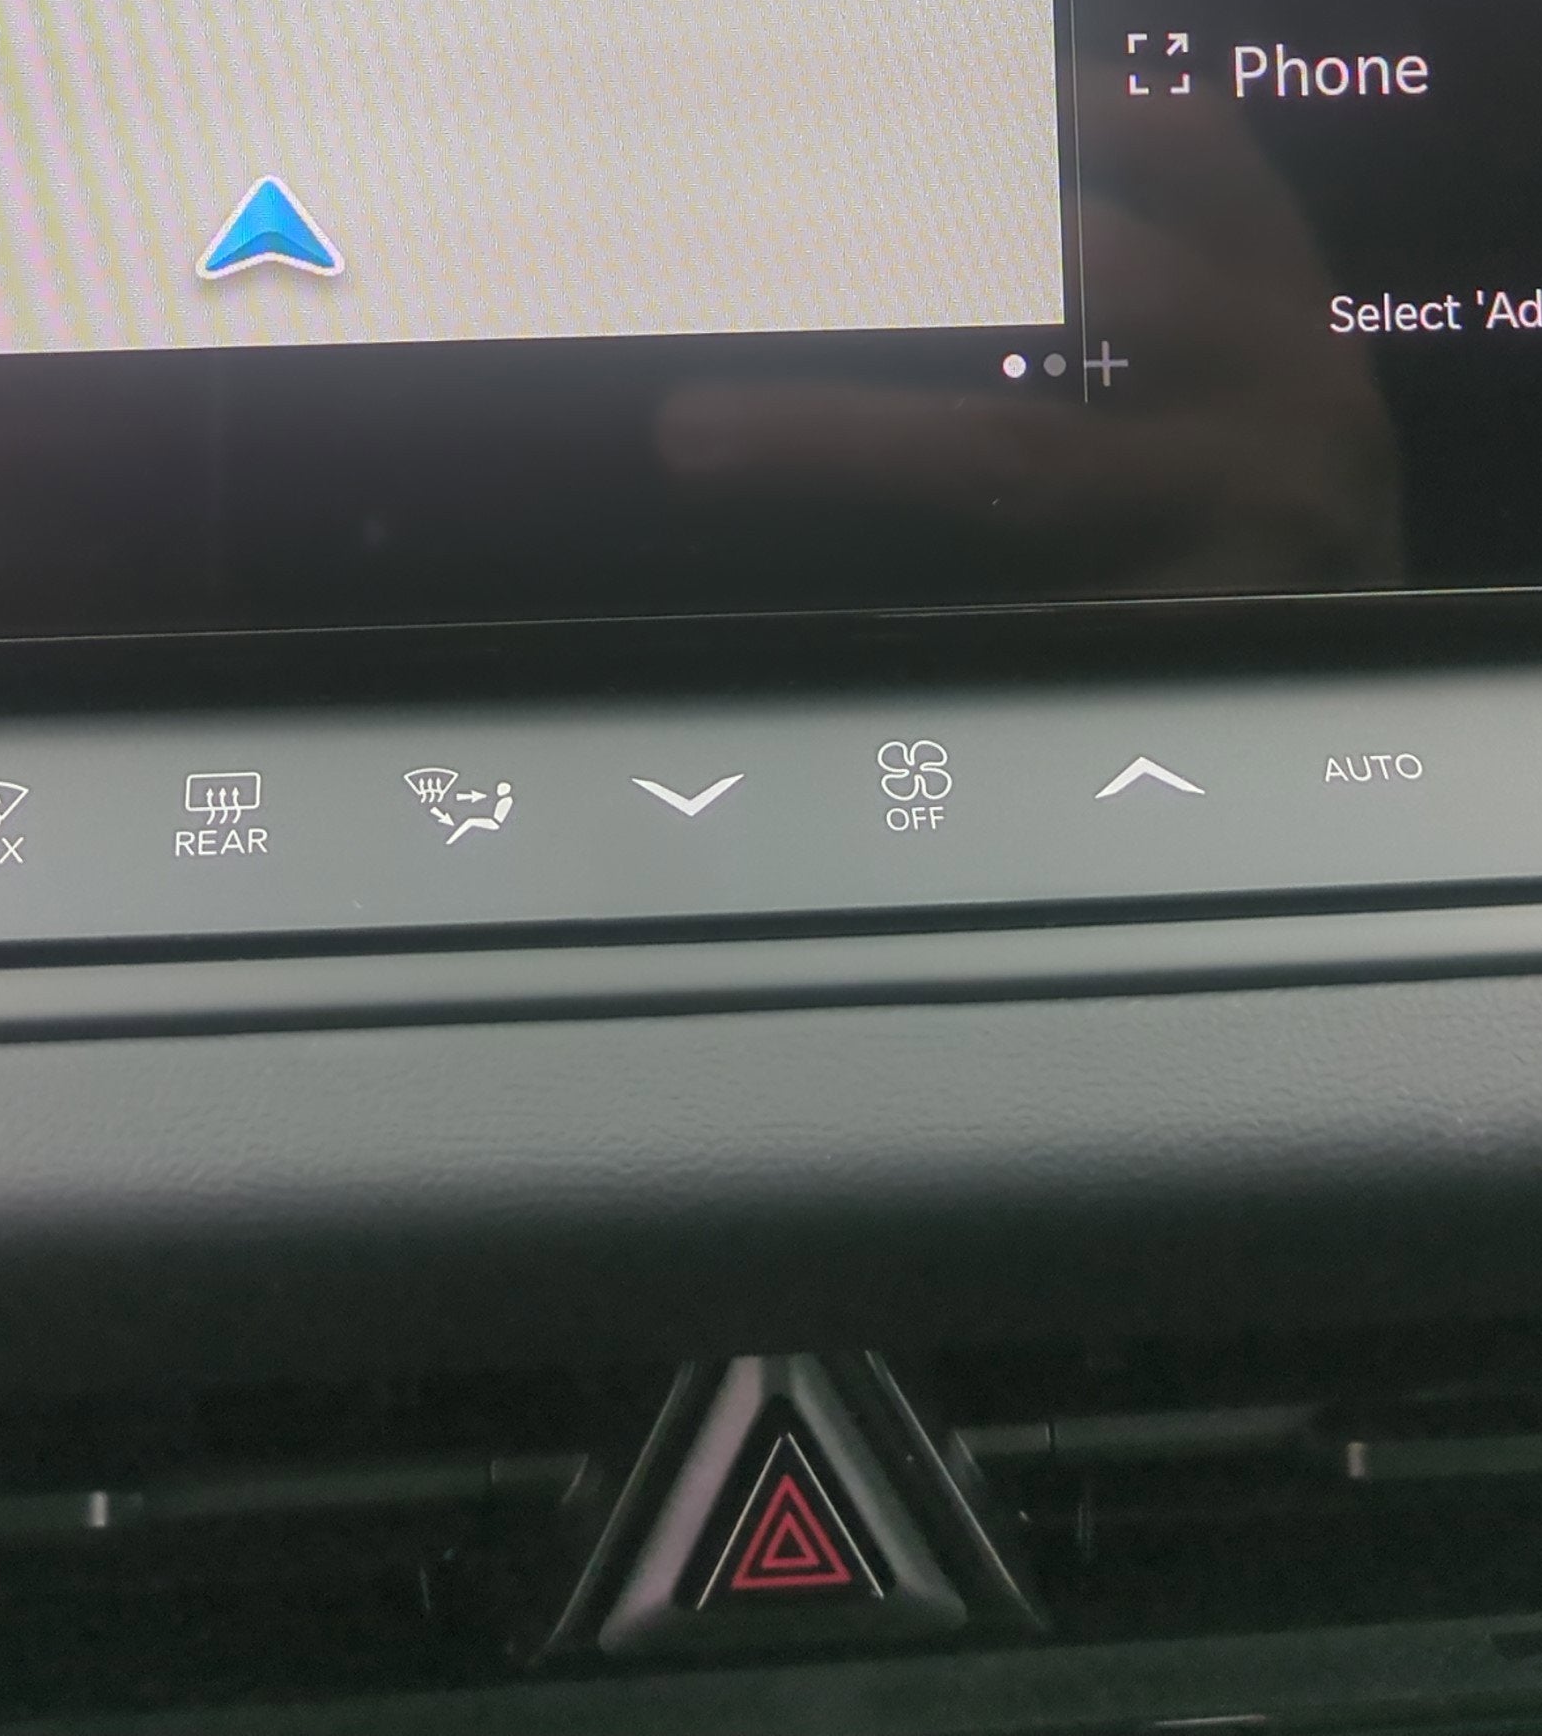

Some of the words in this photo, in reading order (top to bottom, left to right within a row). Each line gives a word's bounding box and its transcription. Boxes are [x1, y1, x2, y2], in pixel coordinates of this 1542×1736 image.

[1231, 45, 1431, 99] Phone
[1329, 293, 1462, 334] Select
[1324, 751, 1424, 784] AUTO
[886, 806, 946, 832] OFF
[175, 828, 269, 857] REAR
